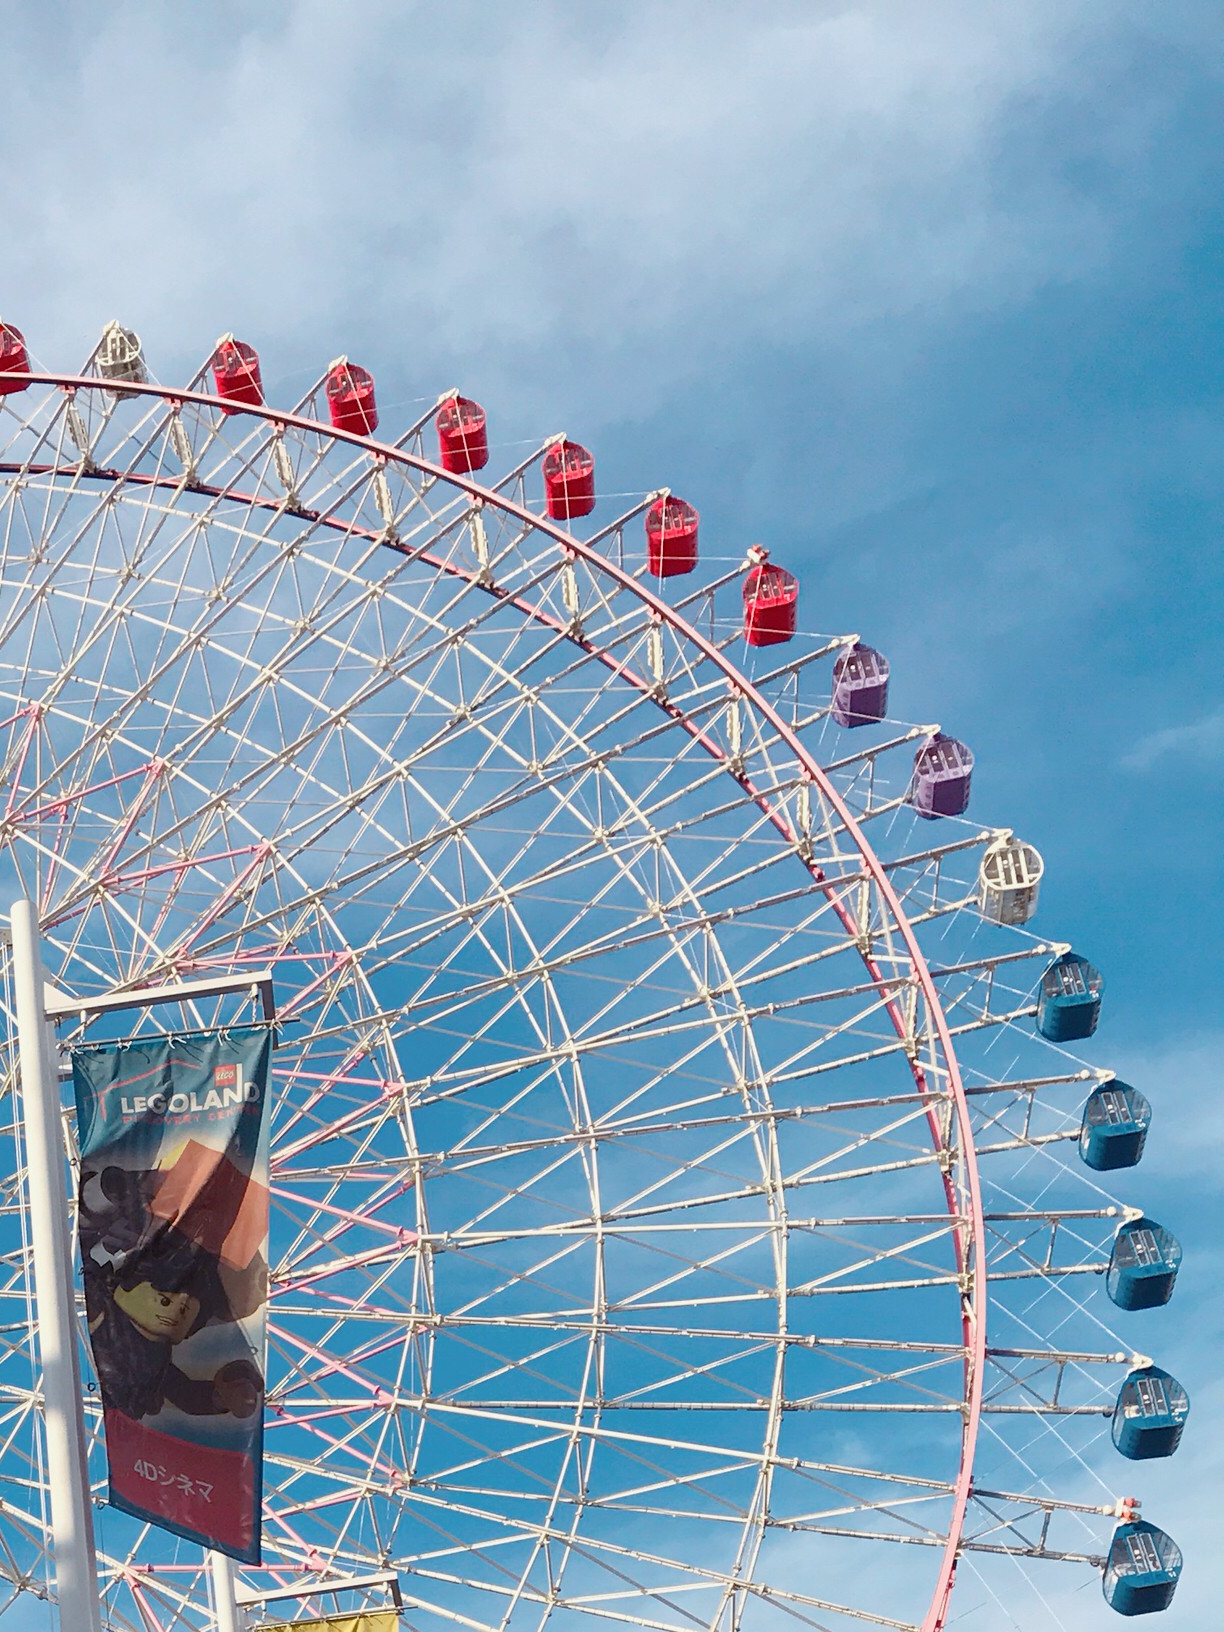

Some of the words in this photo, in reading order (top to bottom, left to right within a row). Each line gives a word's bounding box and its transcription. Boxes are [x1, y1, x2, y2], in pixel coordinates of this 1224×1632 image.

[120, 1064, 261, 1115] LEGOLAND
[134, 1458, 214, 1503] 4Dシネマ
